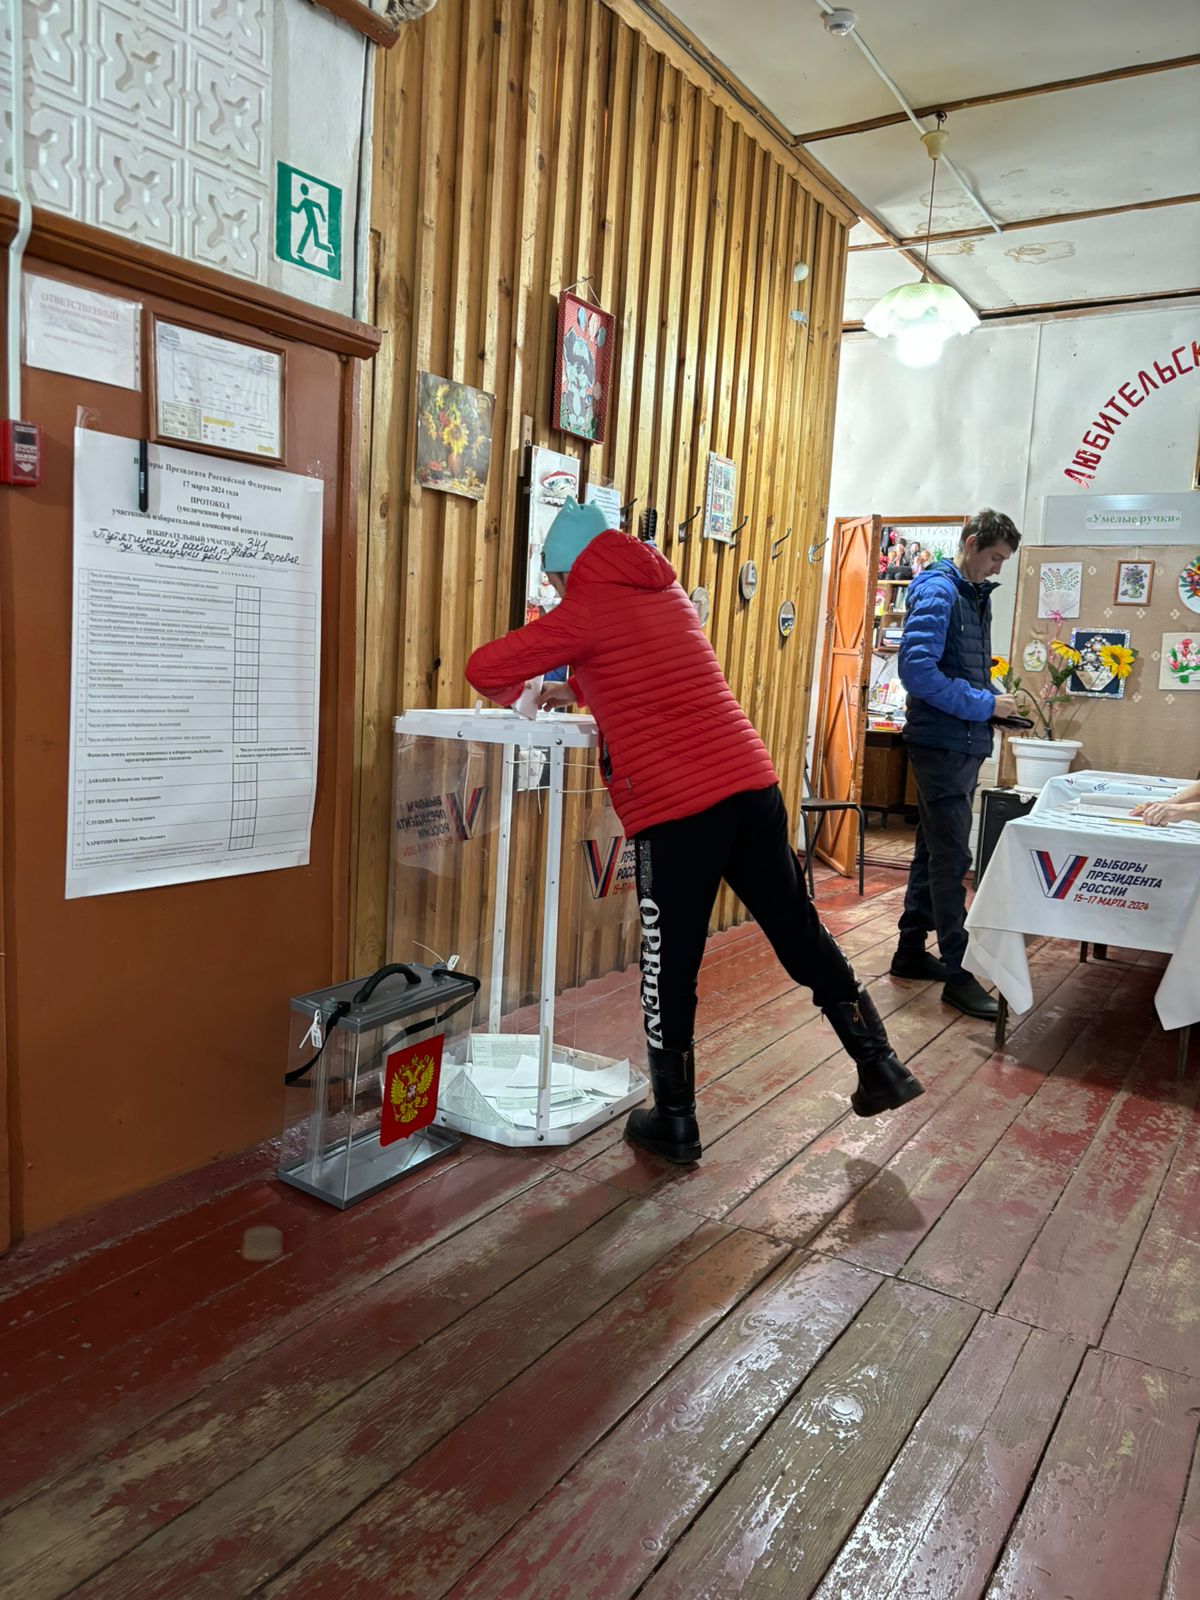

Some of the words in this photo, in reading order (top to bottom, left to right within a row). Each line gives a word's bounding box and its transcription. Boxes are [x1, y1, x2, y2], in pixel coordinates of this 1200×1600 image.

[165, 463, 206, 479] Президента
[208, 471, 246, 486] Российской
[182, 480, 191, 488] 17
[191, 483, 210, 493] марта
[210, 485, 225, 494] 2024
[190, 496, 230, 509] ПРОТОКОЛ
[146, 529, 206, 543] ИЗБИРАТЕЛЬНЫЙ
[206, 536, 236, 547] УЧАСТОК
[246, 537, 268, 553] 341
[1093, 857, 1148, 873] ВЫБОРЫ
[1086, 870, 1163, 889] ПРЕЗИДЕНТА
[1078, 882, 1128, 897] РОССИИ
[1097, 897, 1127, 909] МАРТА
[1127, 900, 1150, 912] 2024
